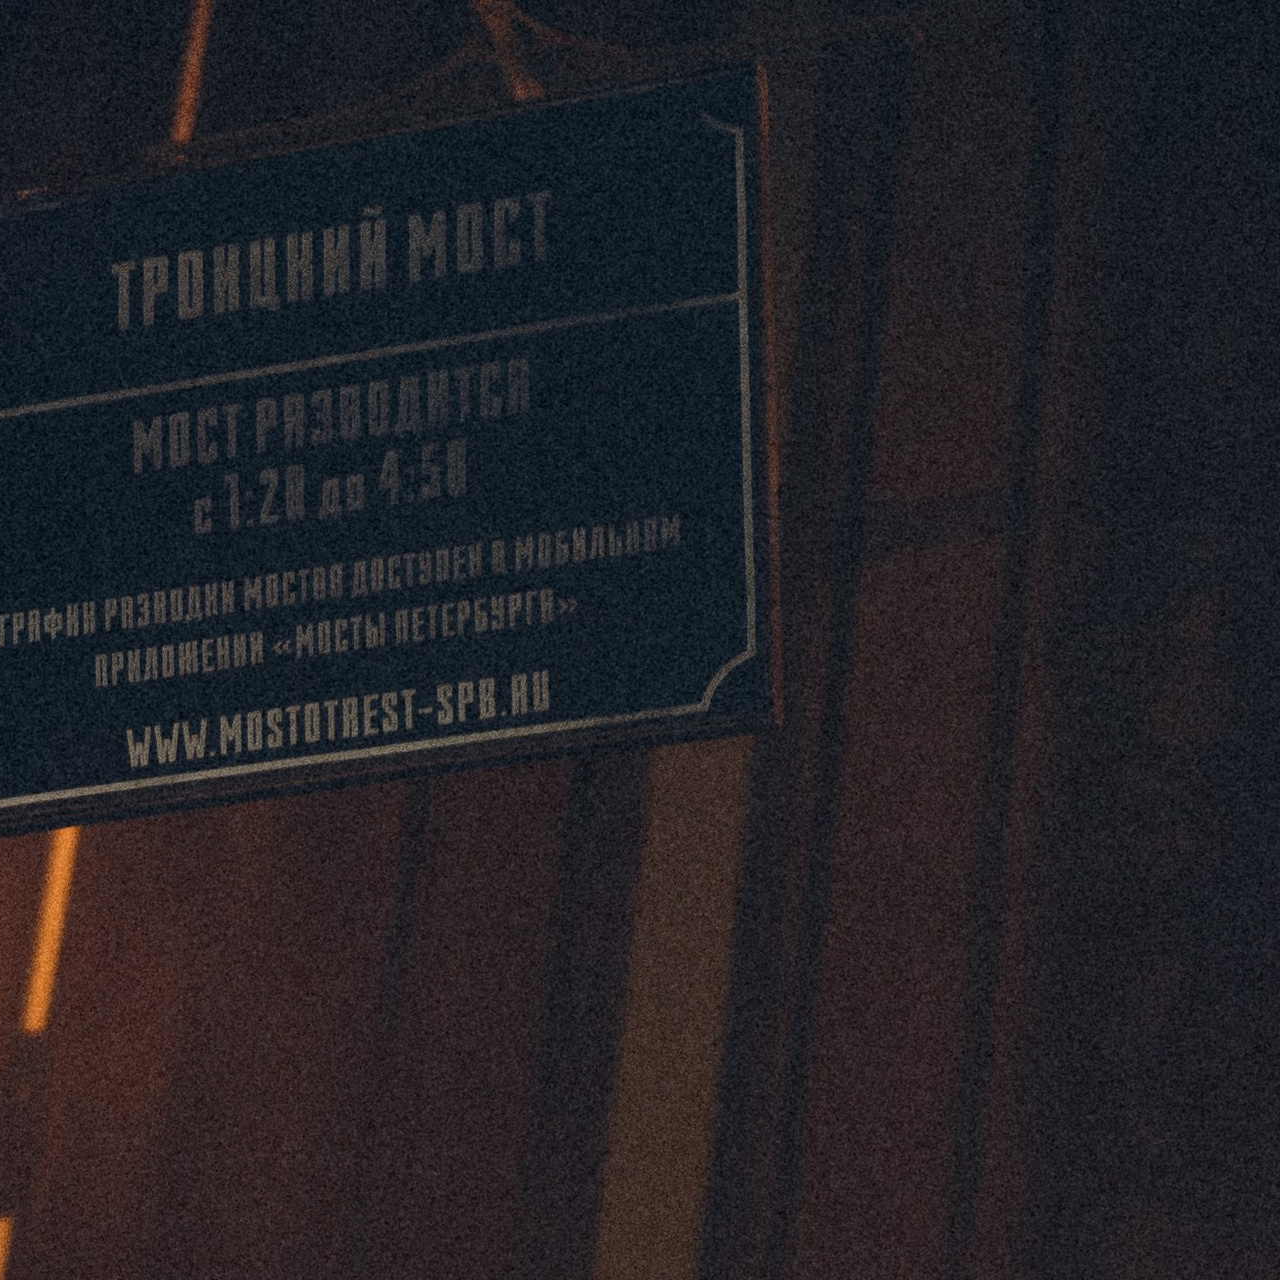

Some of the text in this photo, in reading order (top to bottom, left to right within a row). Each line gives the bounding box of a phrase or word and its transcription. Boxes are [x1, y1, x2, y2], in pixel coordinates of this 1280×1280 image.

[111, 190, 552, 331] ТРОИЦКИЙ МОСТ
[132, 358, 529, 475] МОСТ РАЗВОДИТСЯ
[319, 473, 364, 521] до
[104, 580, 235, 632] РАЗВОДКИ
[243, 563, 344, 612] МОСТОВ
[351, 542, 483, 598] ДОСТУПЕН
[515, 514, 681, 573] МОБИЛЬНОМ
[94, 587, 577, 689] ПРИЛОЖЕНИИ «МОСТЫ ПЕТЕРБУРГА»
[126, 669, 551, 770] WWW.MOSTOTREST-SPB.RU
